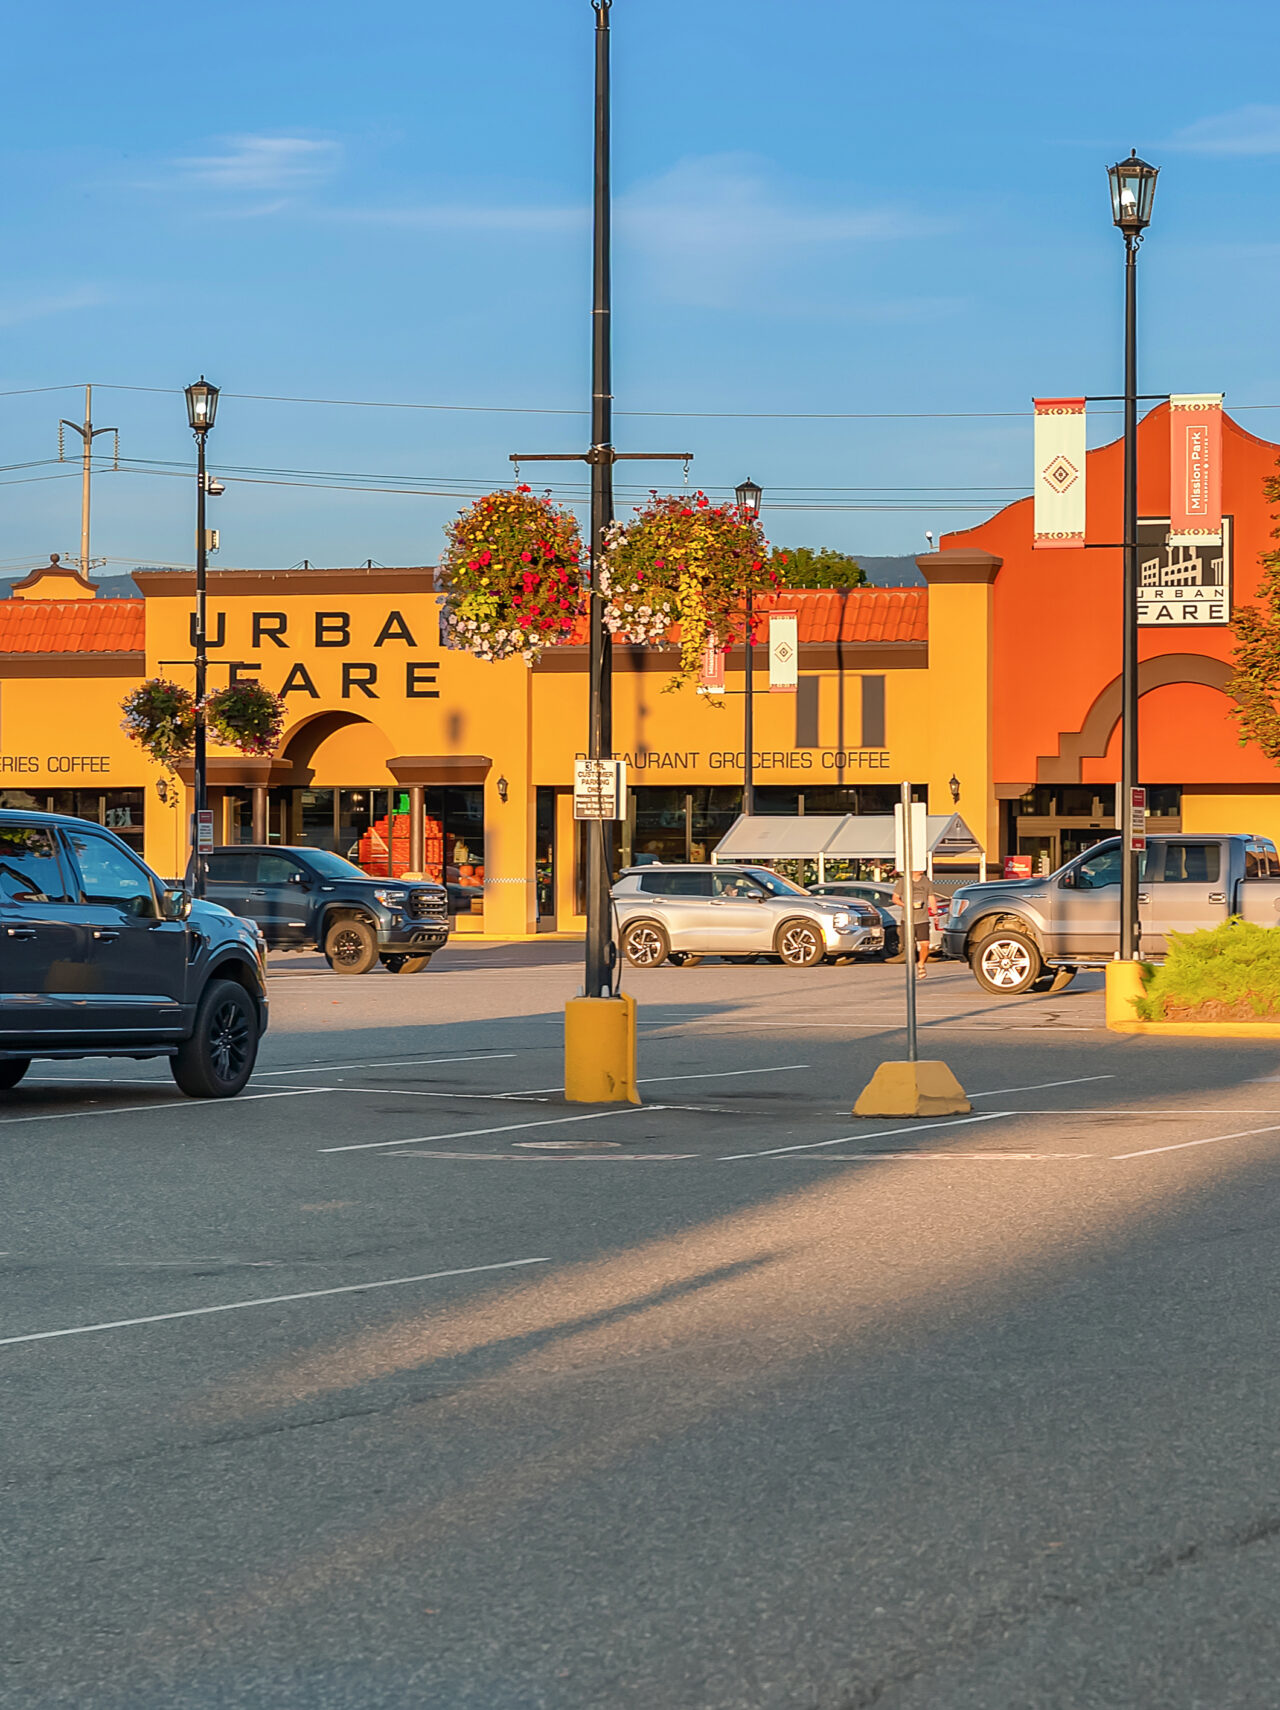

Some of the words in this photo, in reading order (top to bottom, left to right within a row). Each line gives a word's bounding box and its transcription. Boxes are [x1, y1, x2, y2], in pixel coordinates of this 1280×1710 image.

[1191, 431, 1201, 460] Park
[1191, 463, 1201, 509] Mission
[1137, 589, 1224, 599] URBAN
[1137, 604, 1224, 620] FARE
[47, 756, 110, 773] COFFEE
[822, 752, 890, 769] COFFEE
